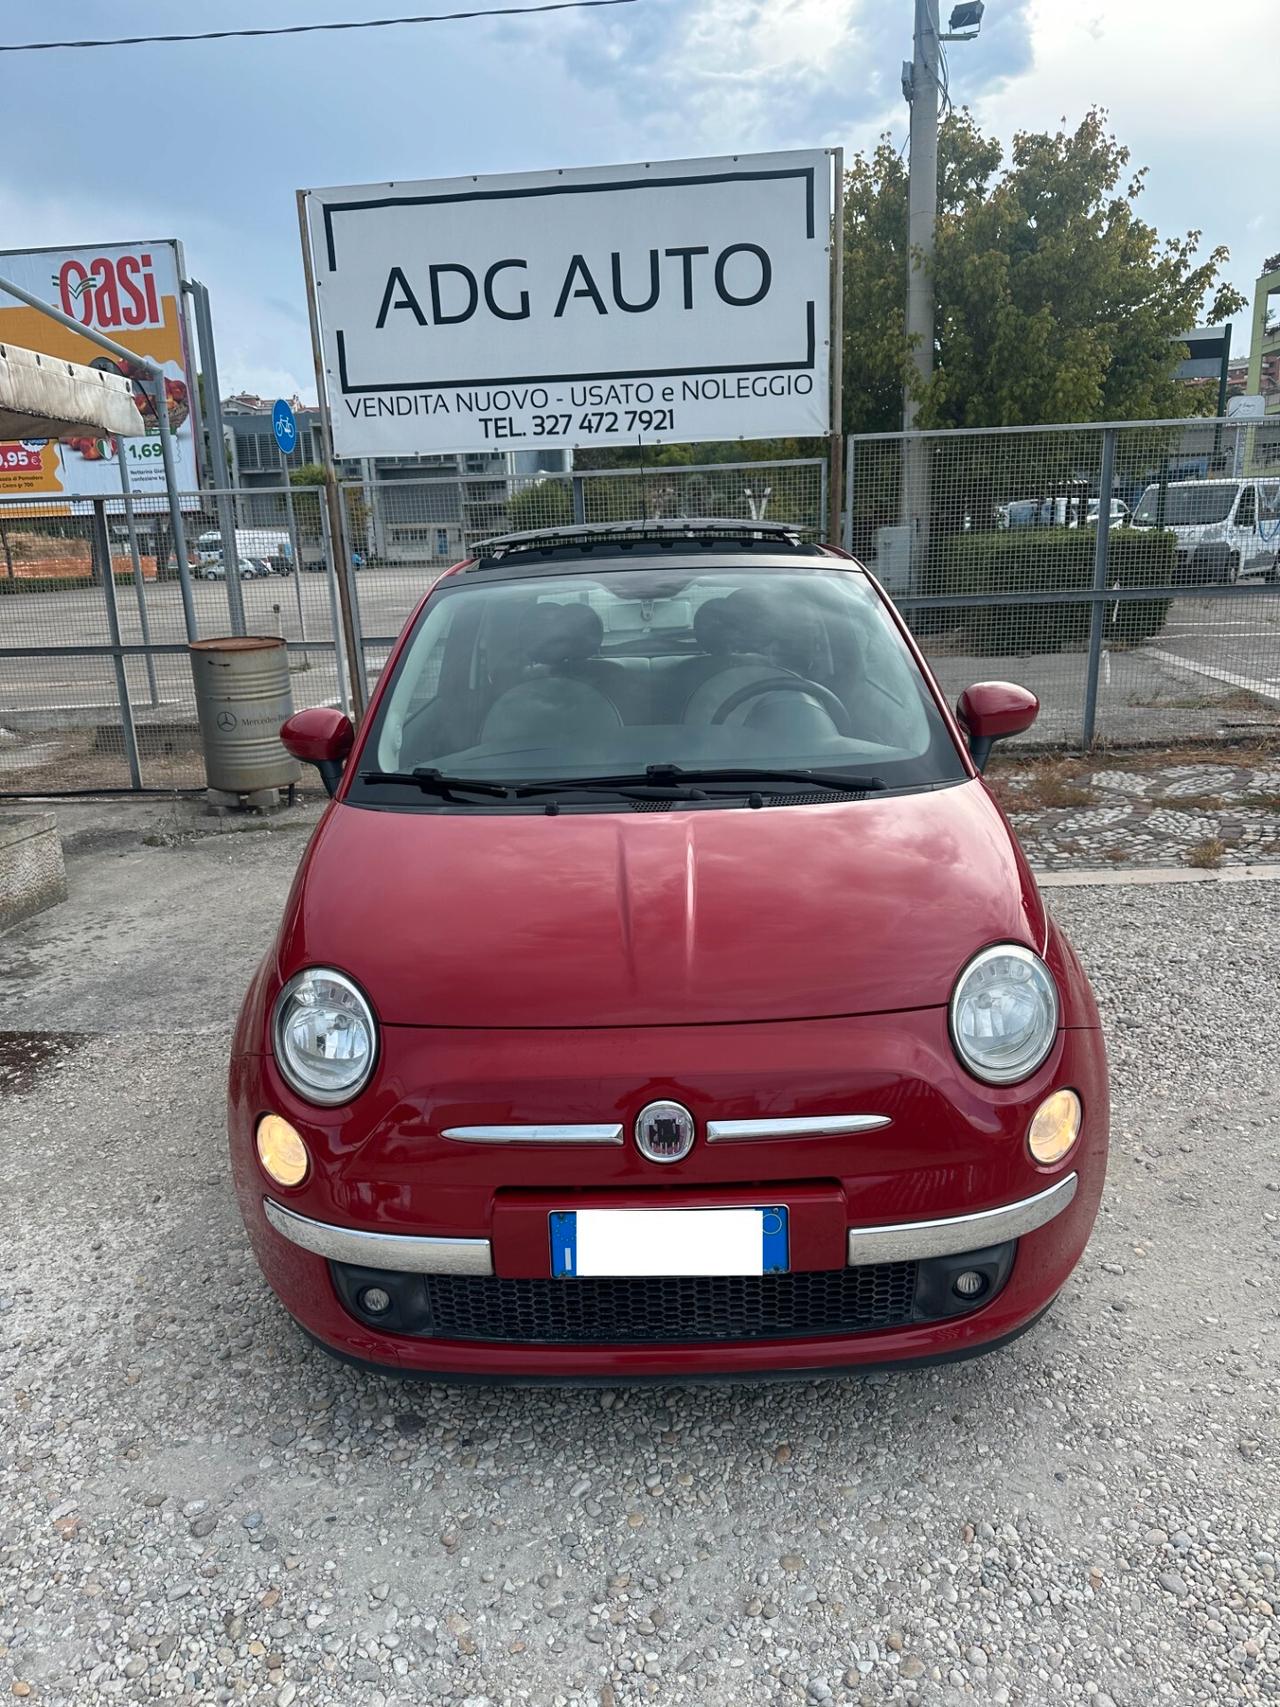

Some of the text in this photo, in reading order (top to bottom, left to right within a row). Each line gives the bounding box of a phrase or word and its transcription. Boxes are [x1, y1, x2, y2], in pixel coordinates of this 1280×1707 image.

[59, 255, 160, 327] Oasi
[376, 243, 772, 328] ADG AUTO
[345, 394, 450, 418] VENDITA
[456, 388, 549, 412] NUOVO
[571, 382, 654, 408] USATO
[661, 388, 674, 402] e
[682, 374, 813, 401] NOLEGGIO
[479, 408, 675, 439] TEL. 327 472 7921
[129, 443, 163, 460] 1,69
